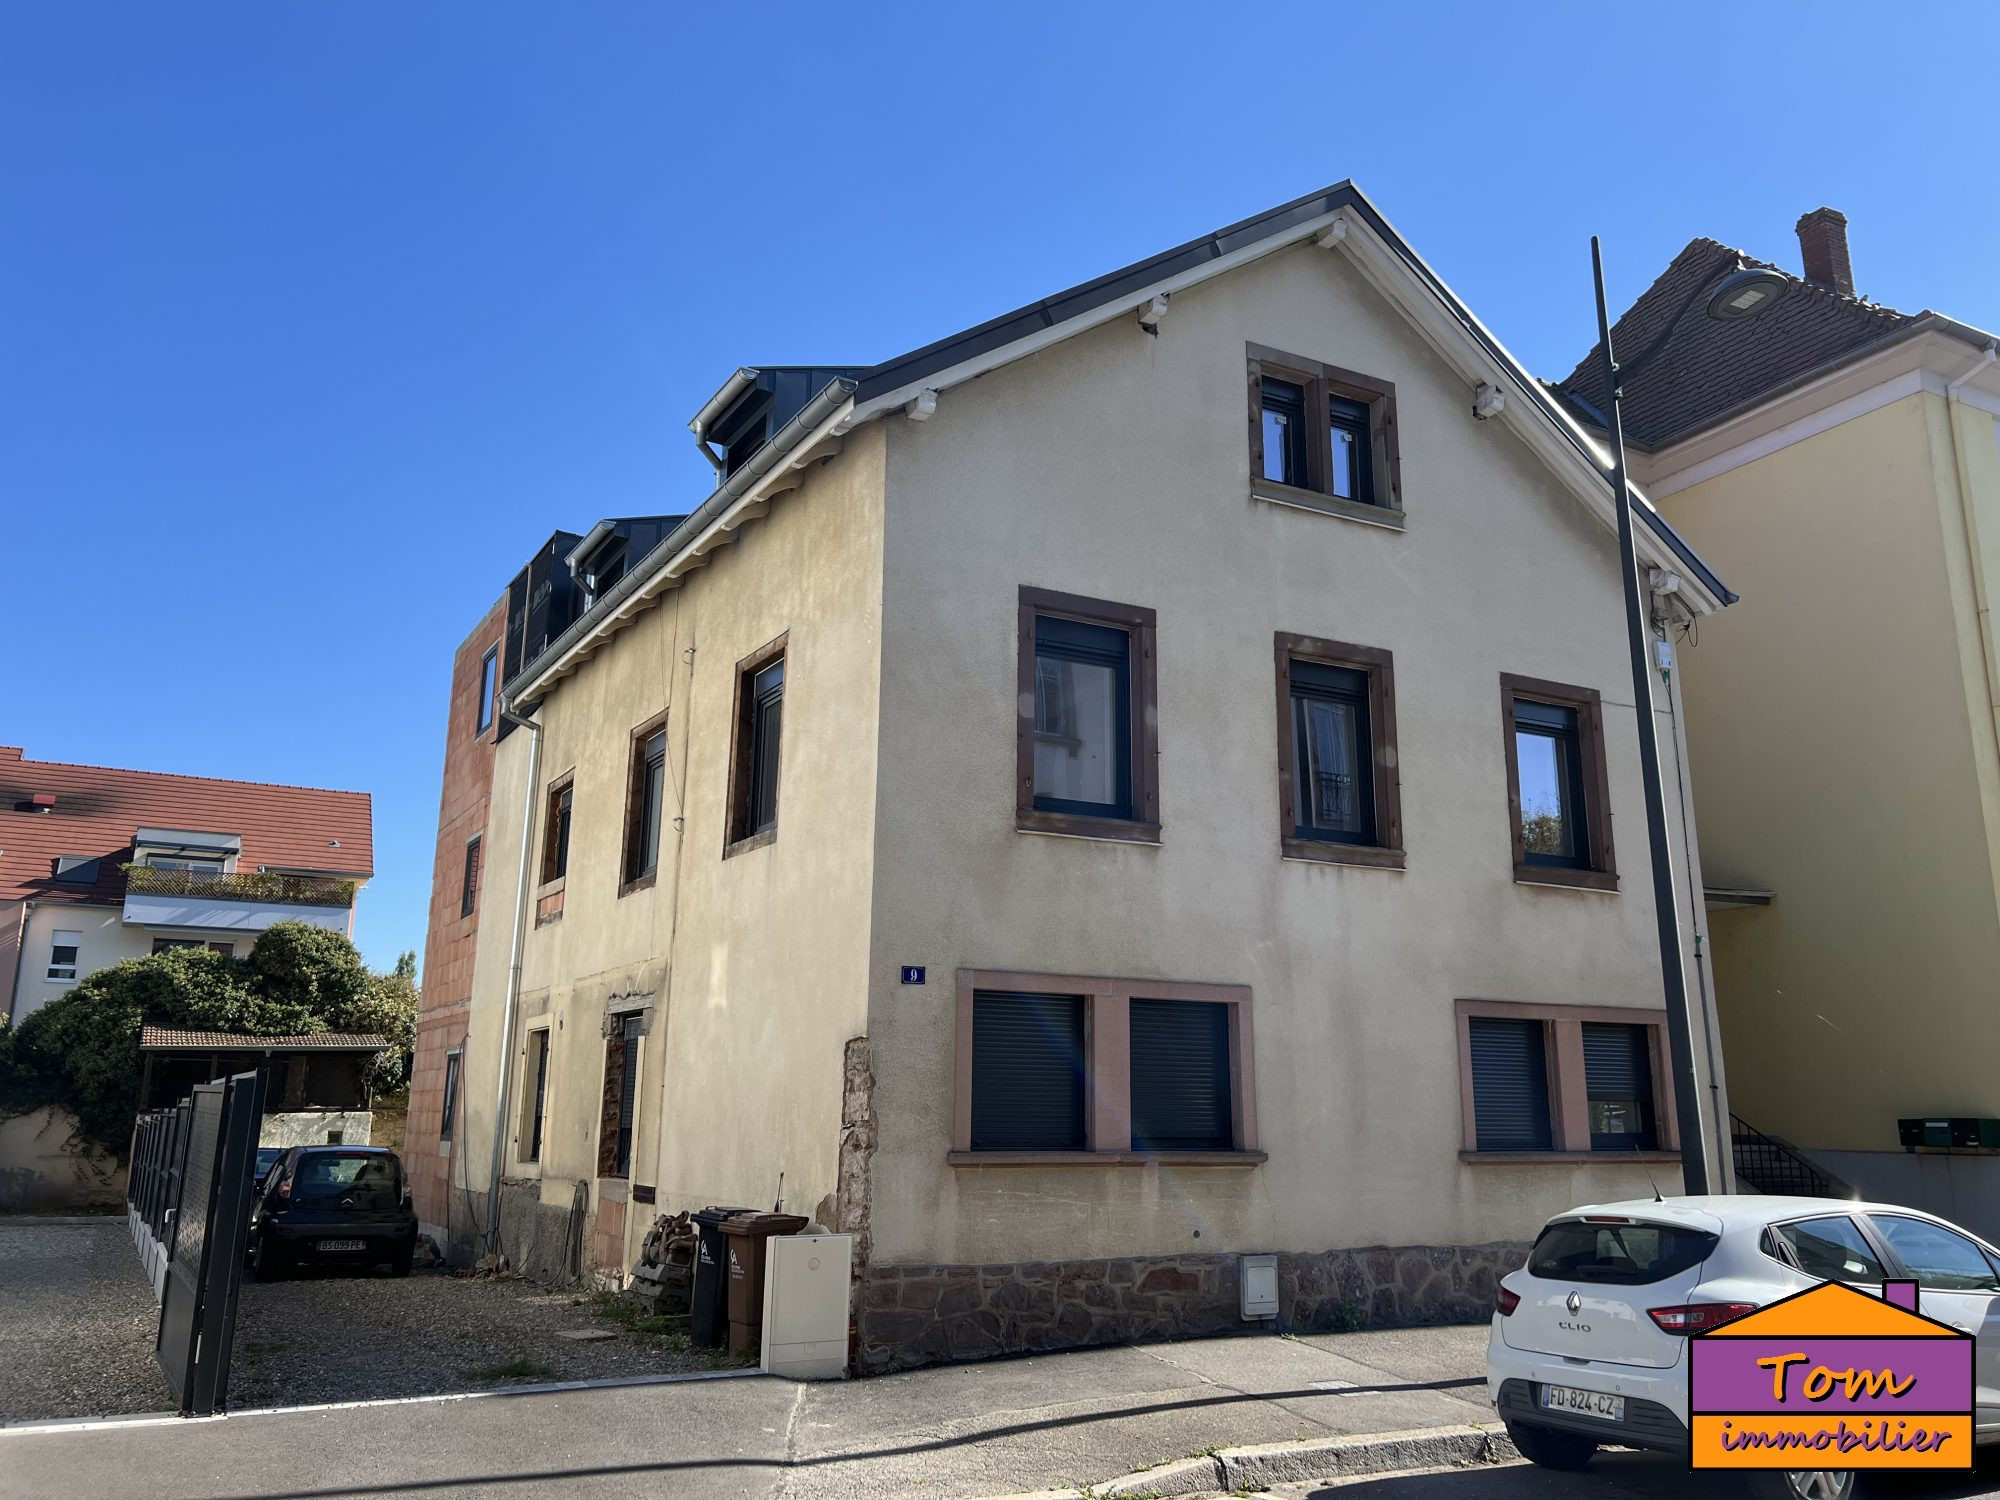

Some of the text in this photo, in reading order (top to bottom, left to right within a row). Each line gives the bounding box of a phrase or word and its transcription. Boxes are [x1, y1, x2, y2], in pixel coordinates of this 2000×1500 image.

[910, 968, 918, 982] 9
[1559, 1321, 1591, 1332] CLIO
[1550, 1387, 1614, 1415] FD-824-CZ
